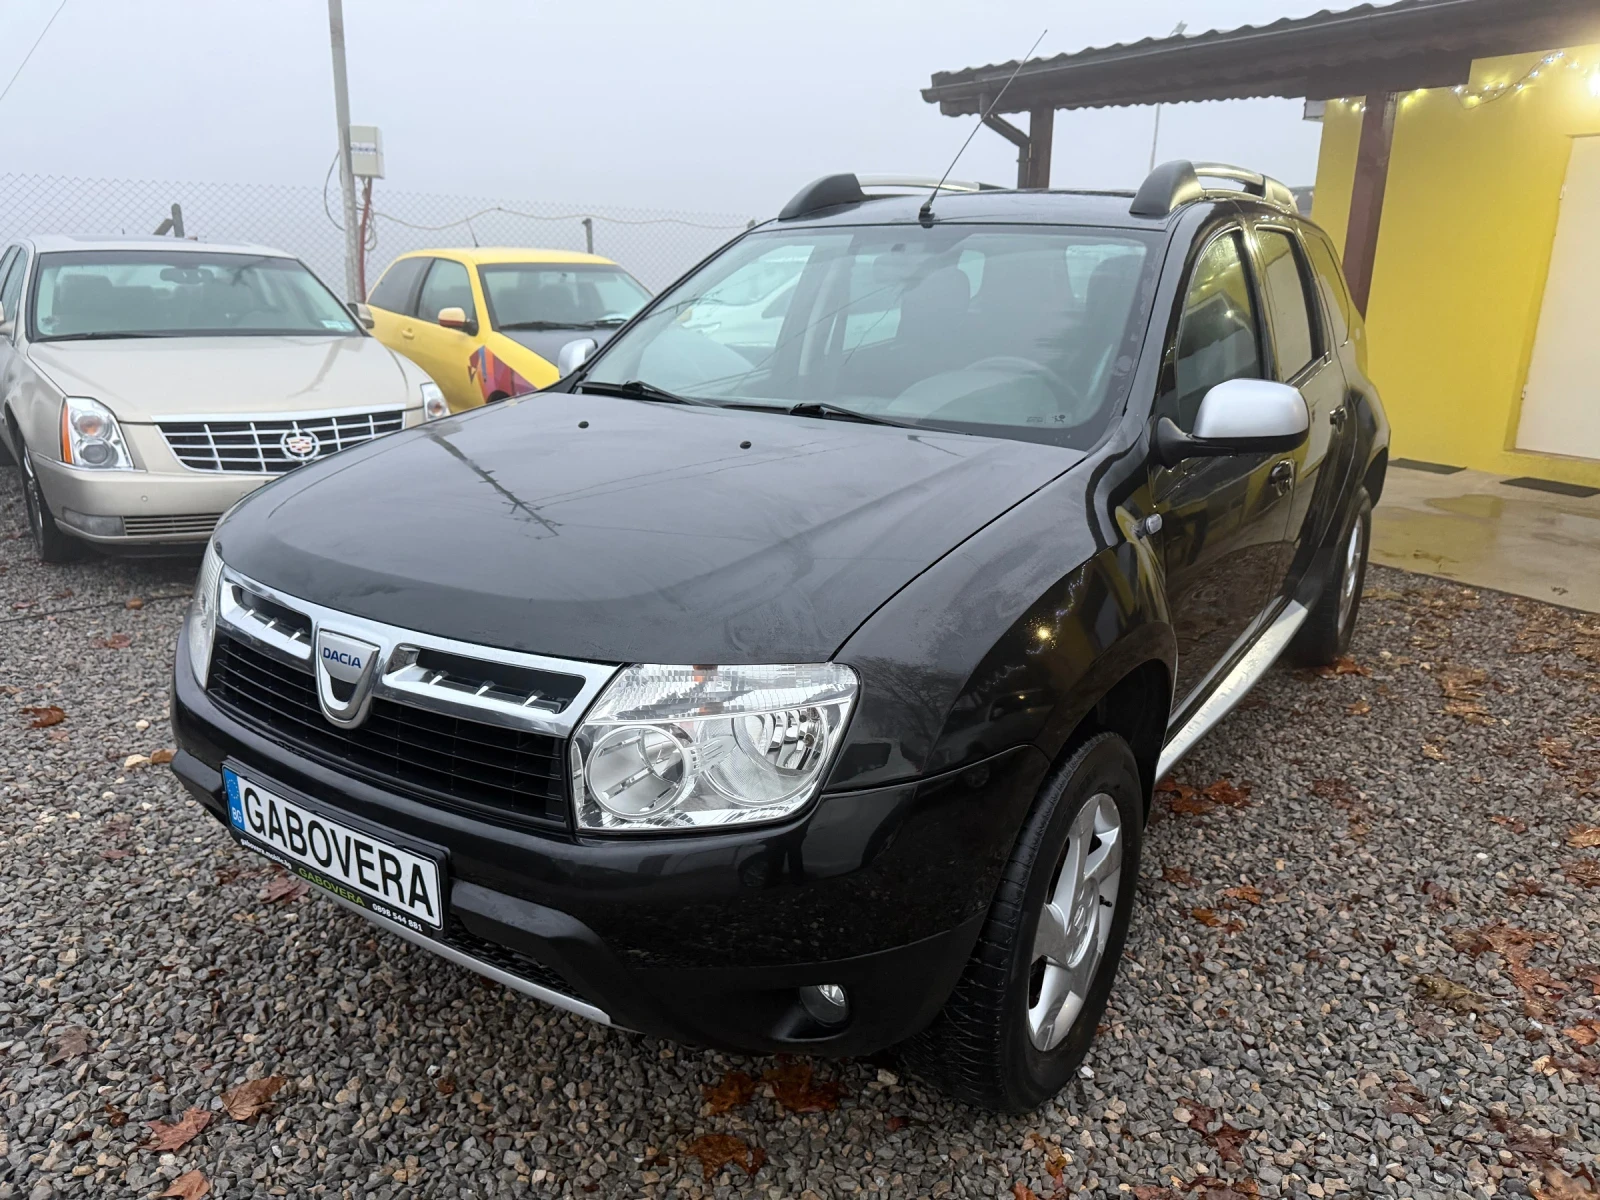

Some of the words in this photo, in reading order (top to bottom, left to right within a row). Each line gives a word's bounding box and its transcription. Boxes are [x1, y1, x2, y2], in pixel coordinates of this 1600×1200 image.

[323, 647, 361, 669] DACIA
[232, 806, 242, 823] BG
[244, 787, 435, 919] GABOVERA
[299, 867, 366, 906] GABOVERA
[372, 903, 391, 917] 0898
[392, 911, 407, 925] 544
